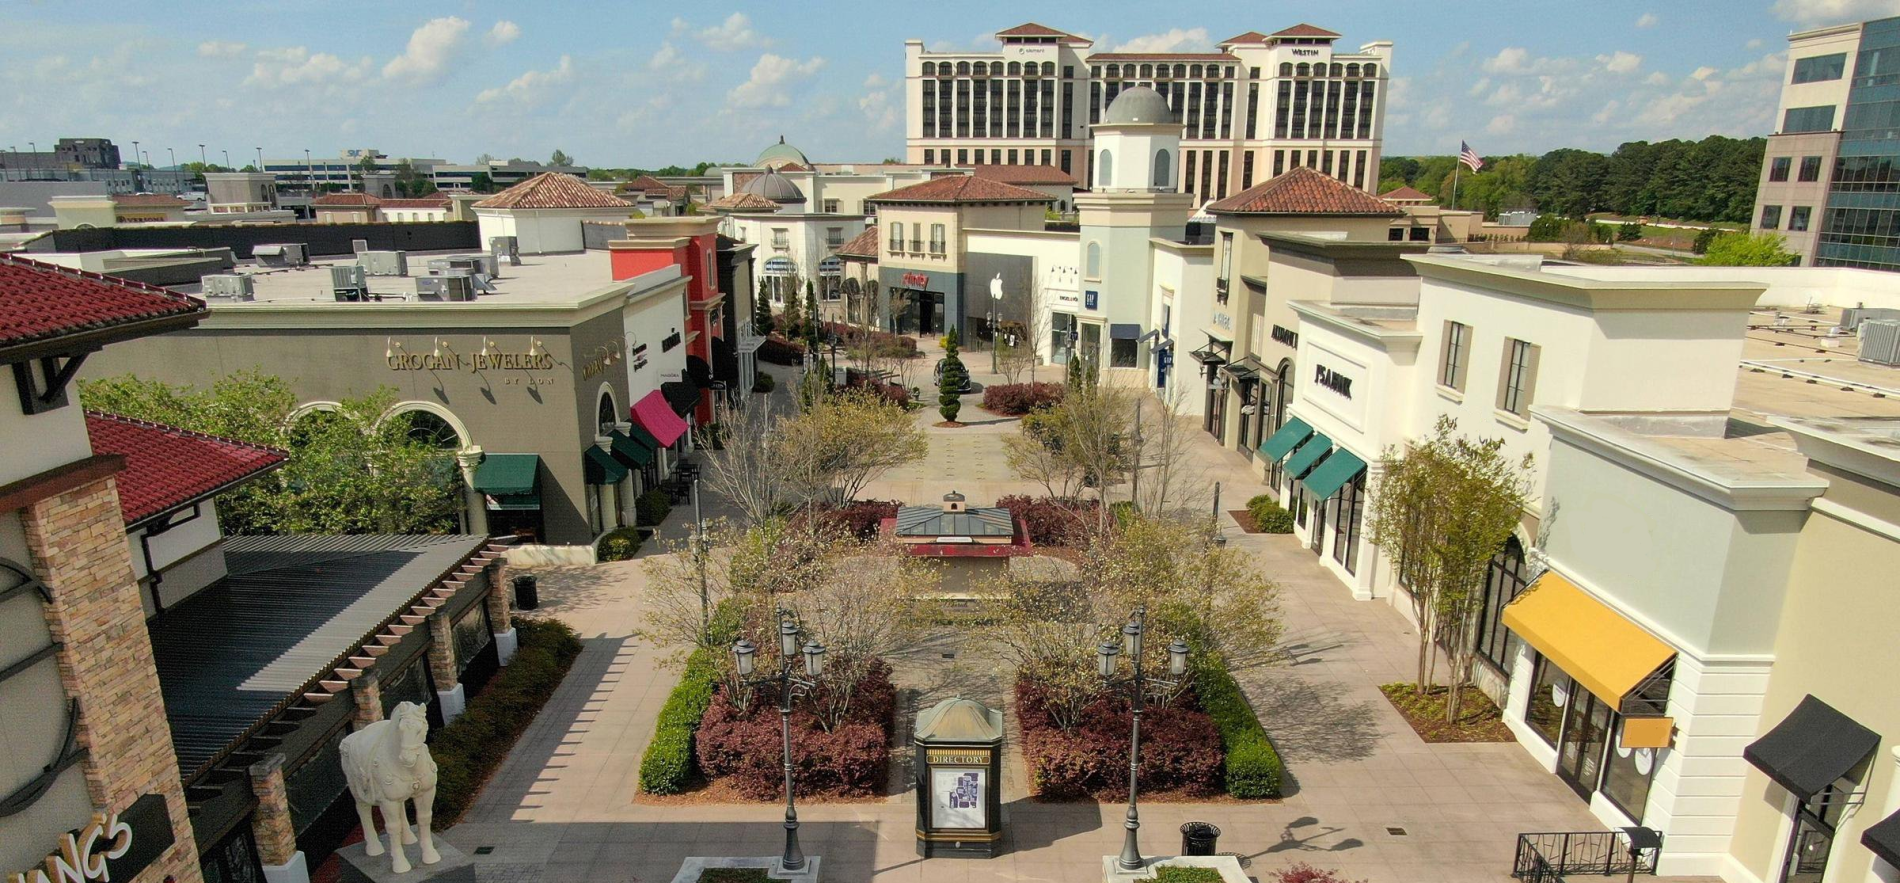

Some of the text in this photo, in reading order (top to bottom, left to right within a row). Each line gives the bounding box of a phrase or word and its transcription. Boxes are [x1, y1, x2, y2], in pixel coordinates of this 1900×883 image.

[386, 353, 554, 373] GROGAN JEWELERS
[505, 377, 520, 385] BY
